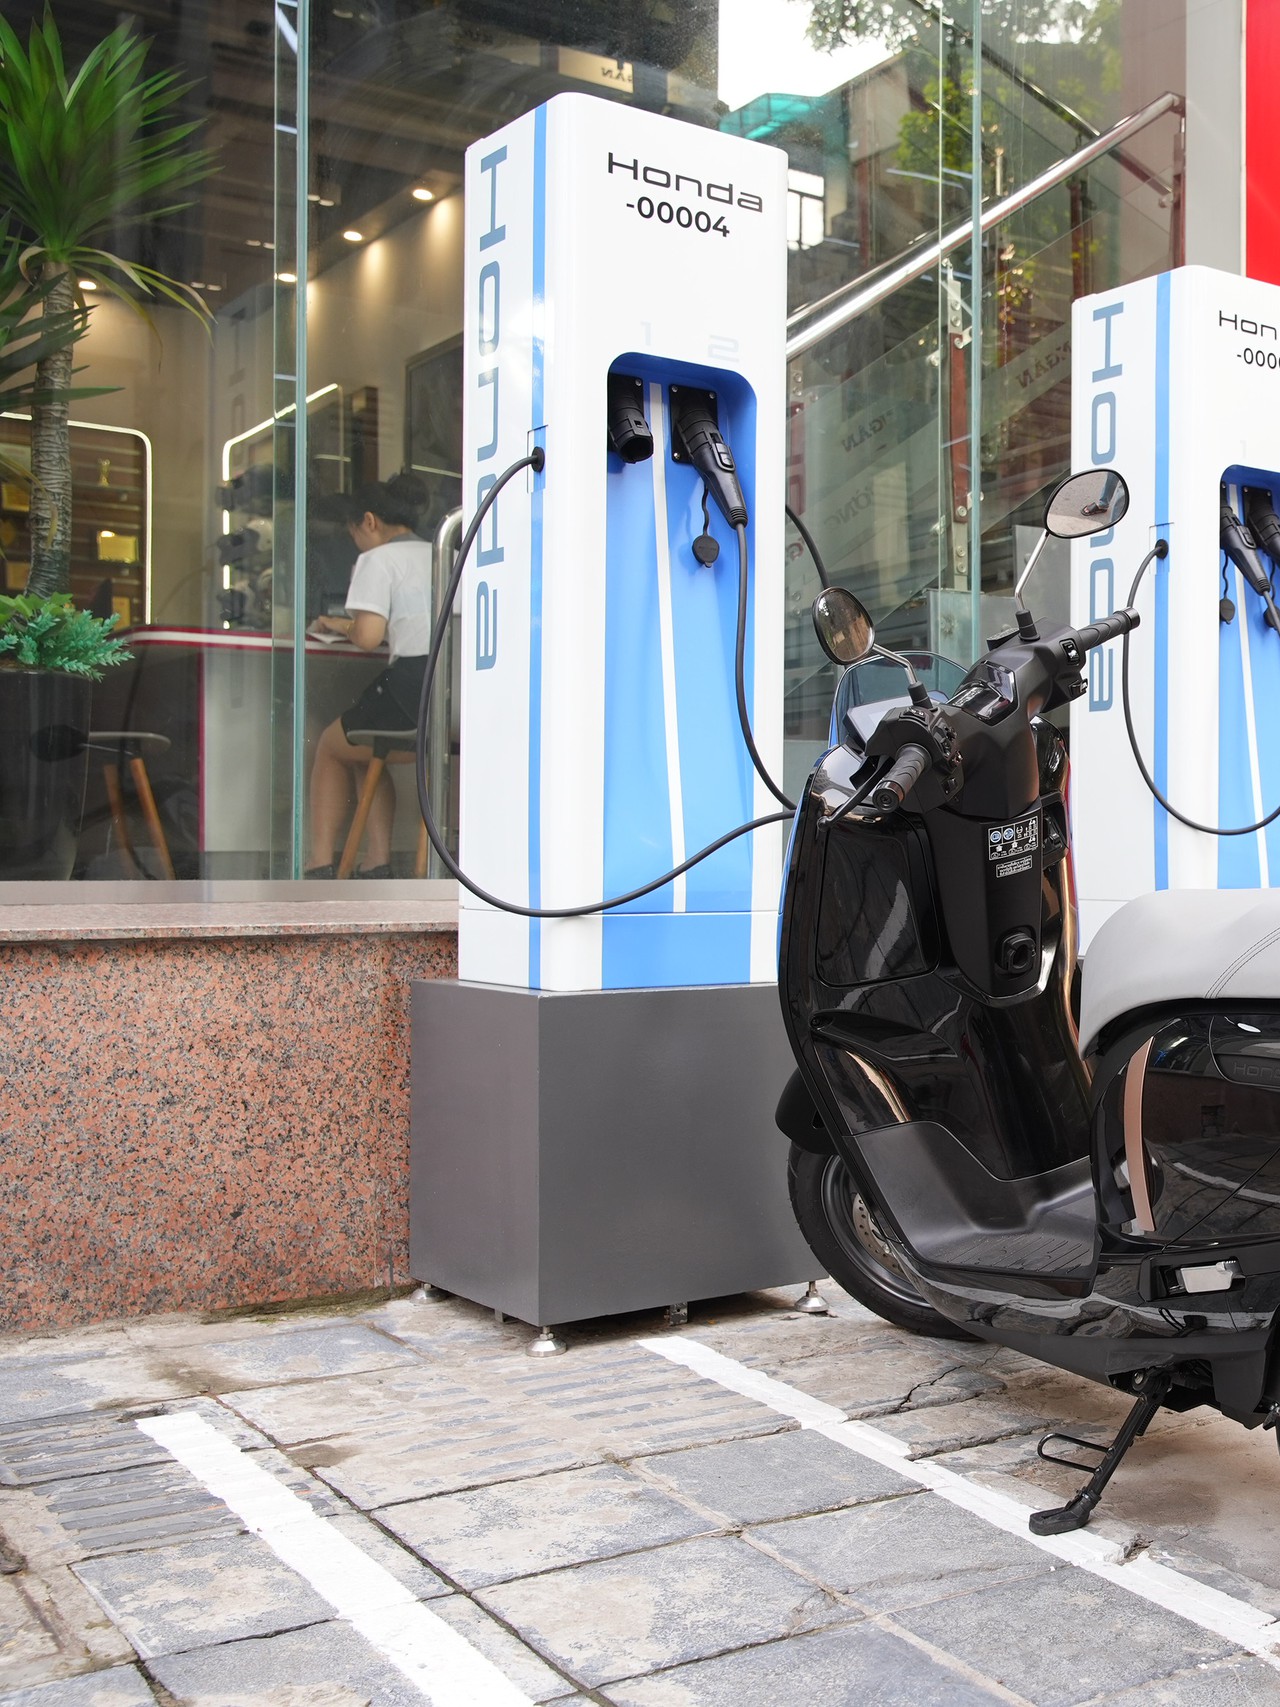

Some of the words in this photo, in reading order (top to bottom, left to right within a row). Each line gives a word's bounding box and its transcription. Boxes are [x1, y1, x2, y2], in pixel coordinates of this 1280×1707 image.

[608, 152, 763, 213] Honda
[626, 195, 731, 238] -00004
[475, 145, 508, 671] Honda
[1089, 302, 1124, 712] Hoda
